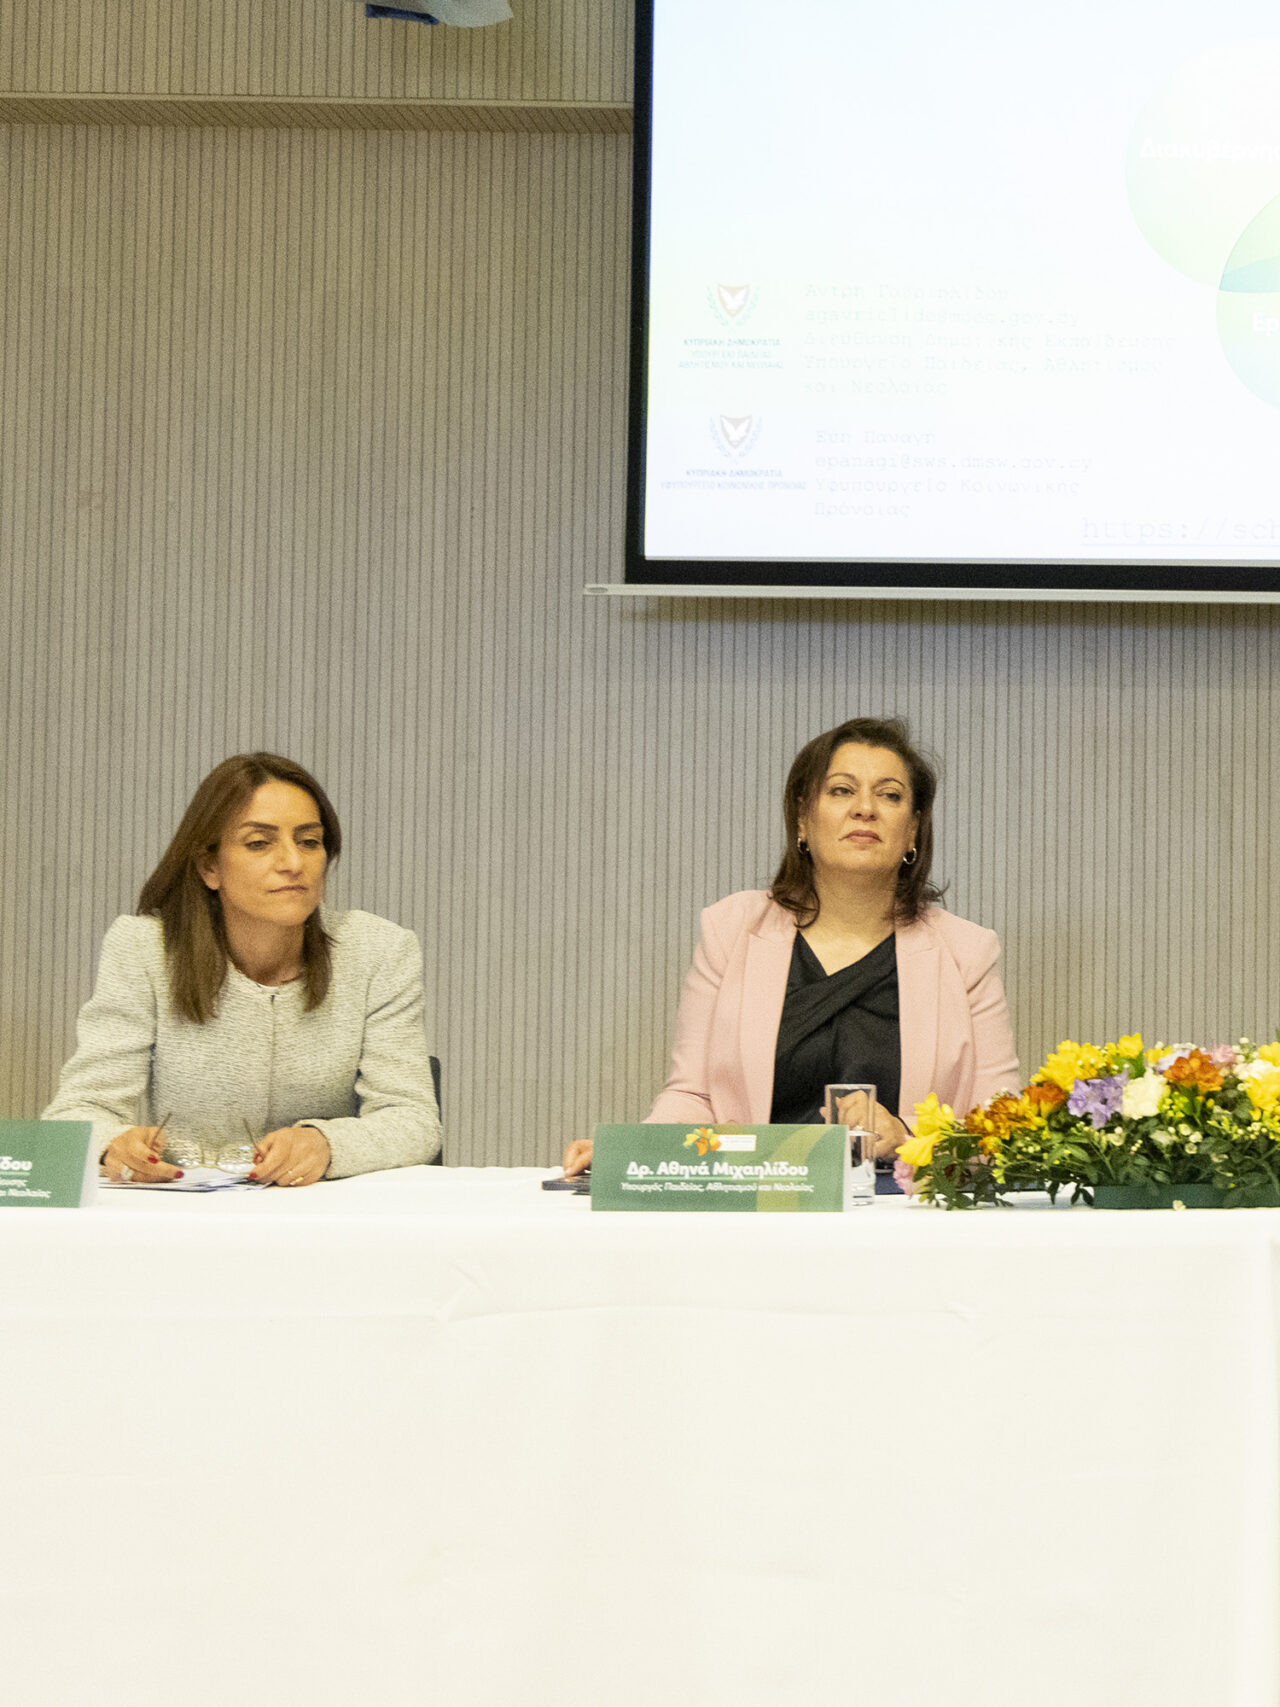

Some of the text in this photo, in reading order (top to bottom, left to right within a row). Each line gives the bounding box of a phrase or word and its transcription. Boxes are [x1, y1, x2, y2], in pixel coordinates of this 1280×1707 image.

[626, 1160, 808, 1179] Δρ. Αθηνά Μιχαηλίδου
